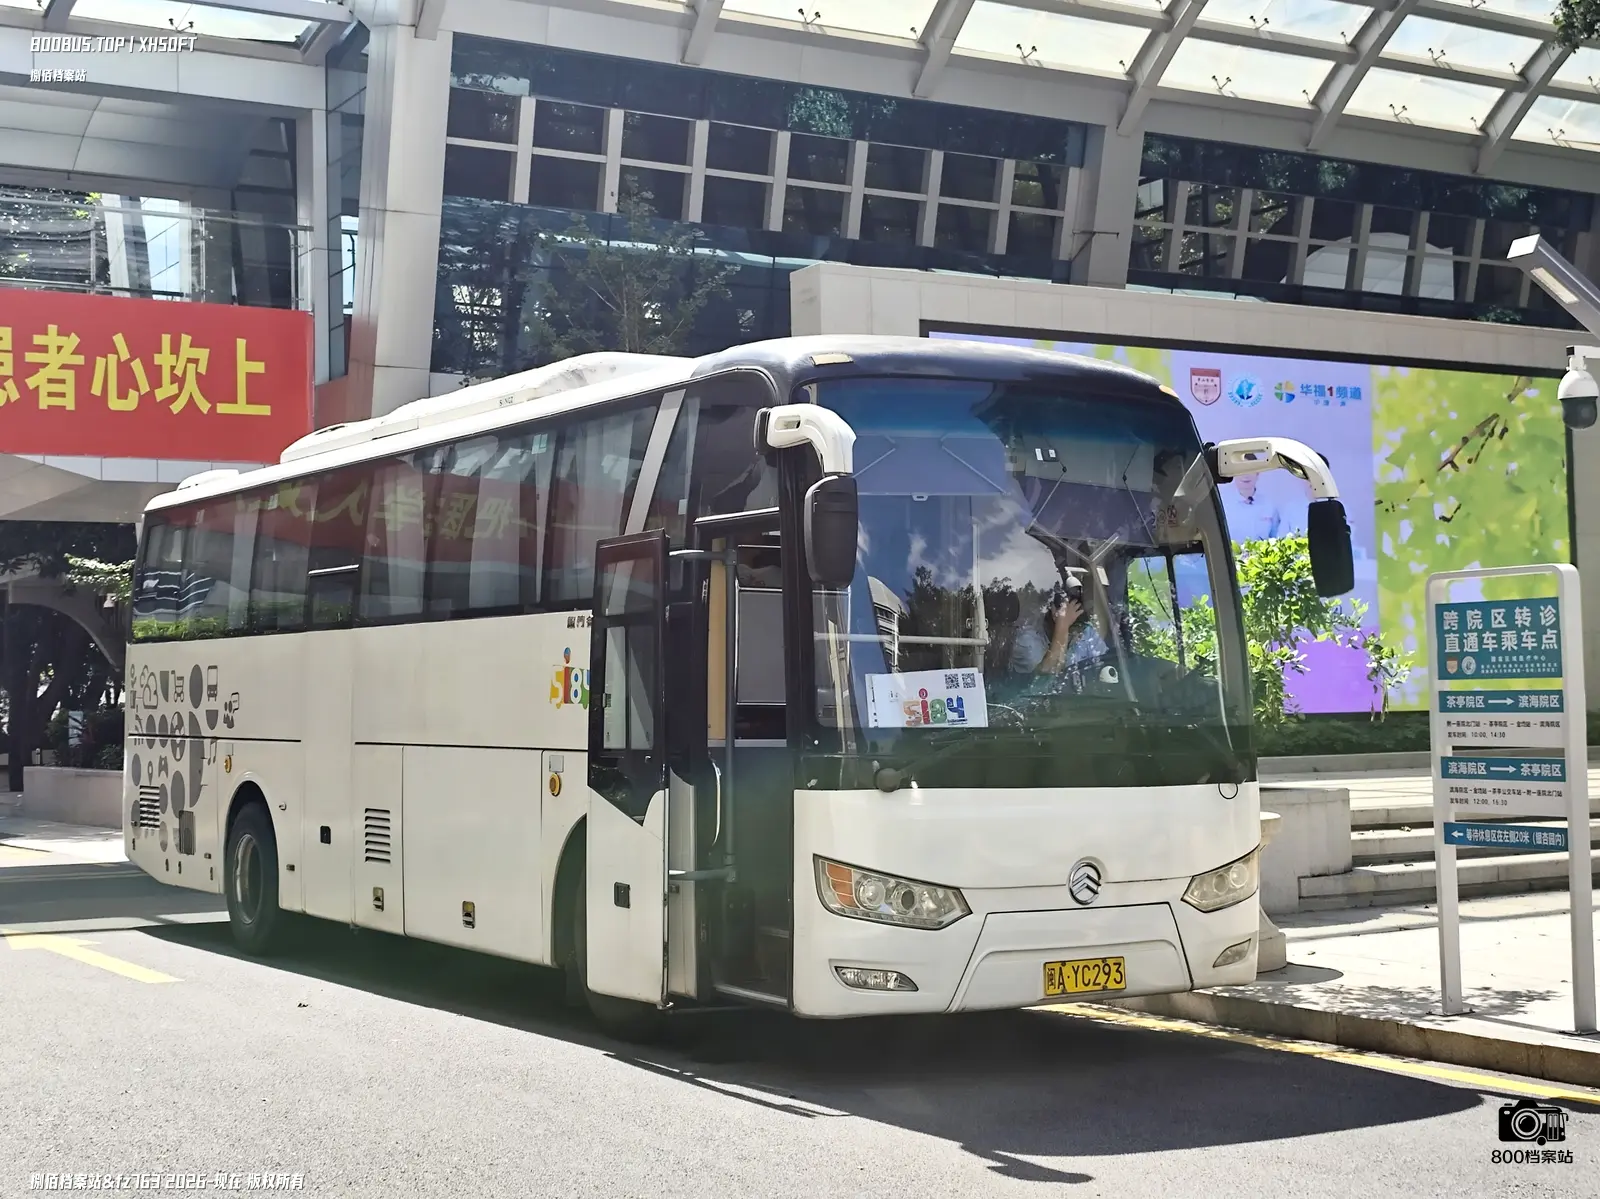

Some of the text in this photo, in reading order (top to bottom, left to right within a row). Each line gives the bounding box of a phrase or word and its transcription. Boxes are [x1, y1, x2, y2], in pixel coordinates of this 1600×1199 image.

[1443, 604, 1557, 631] 跨院区转诊
[1444, 628, 1559, 653] 直通车乘车点
[1446, 694, 1560, 708] 茶亭院区 滨海院区
[1448, 761, 1562, 777] 滨海院区 茶亭院区
